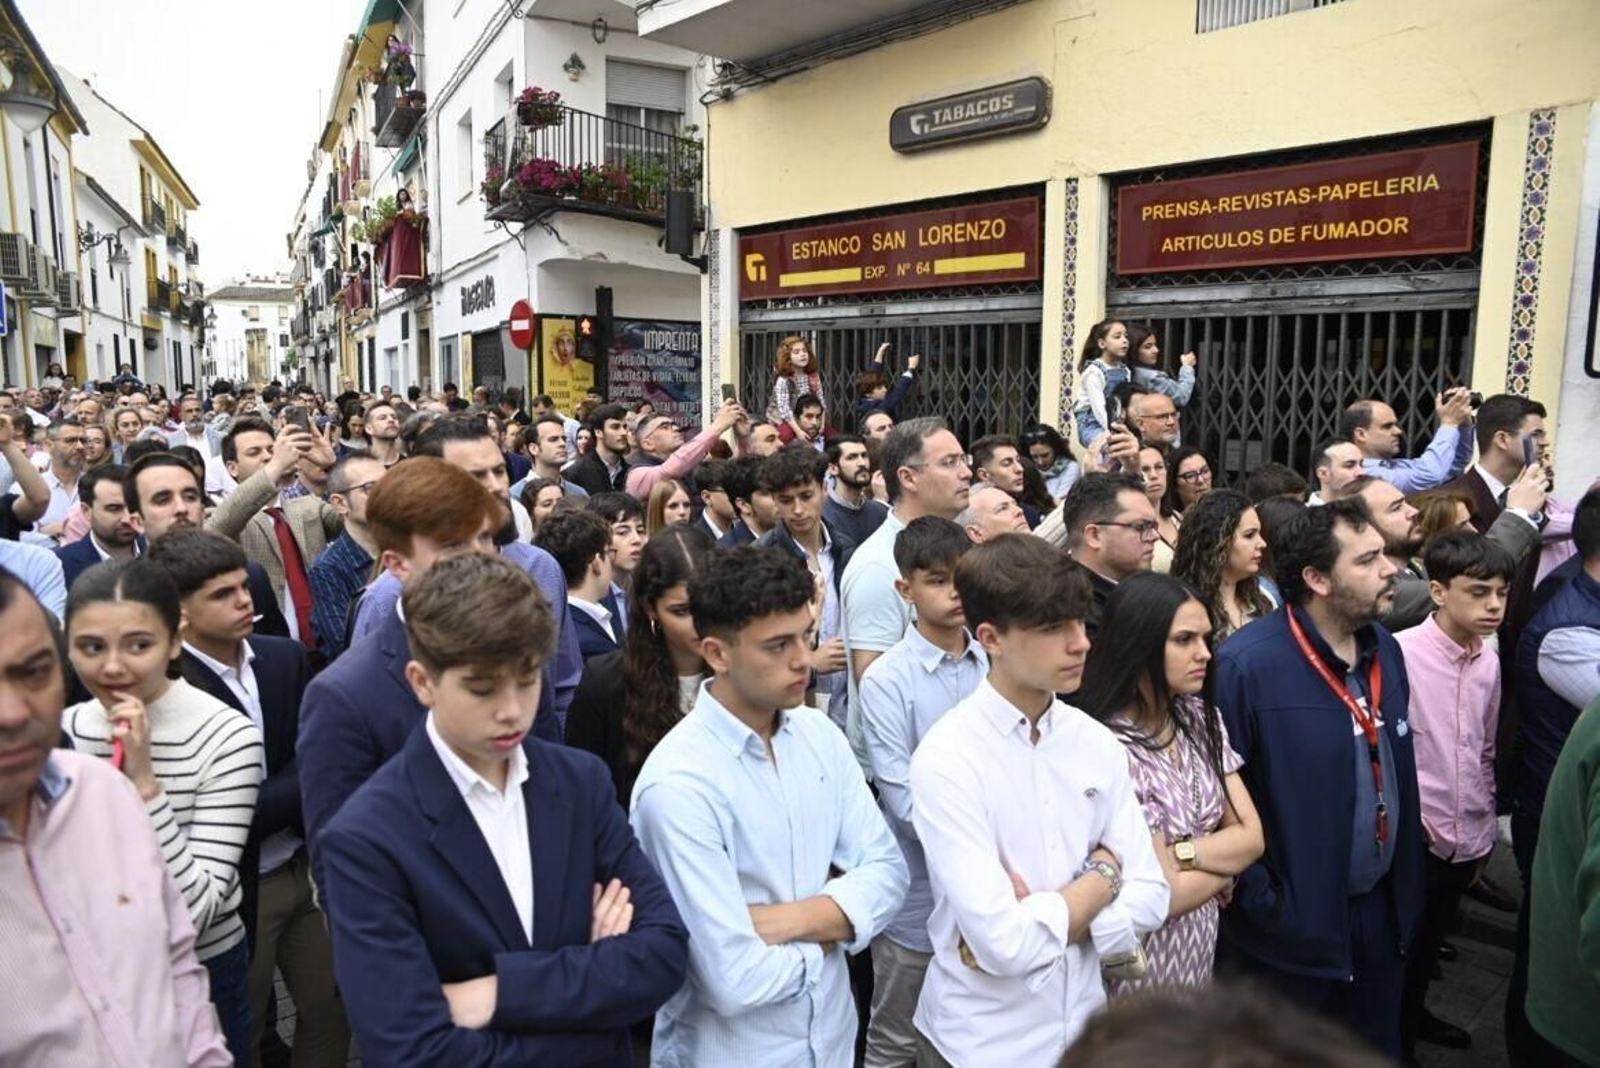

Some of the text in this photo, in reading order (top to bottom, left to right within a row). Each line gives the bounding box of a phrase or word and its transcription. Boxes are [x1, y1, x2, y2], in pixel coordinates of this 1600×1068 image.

[933, 94, 1015, 125] TABACOS
[1141, 173, 1440, 221] PRENSA-REVISTAS-PAPELERIA
[792, 218, 1006, 261] ESTANCO SAN LORENZO
[1161, 217, 1410, 253] ARTICULOS DE FUMADOR
[864, 265, 888, 280] EXP.
[916, 261, 931, 275] 64
[644, 330, 699, 351] IMPRENTA
